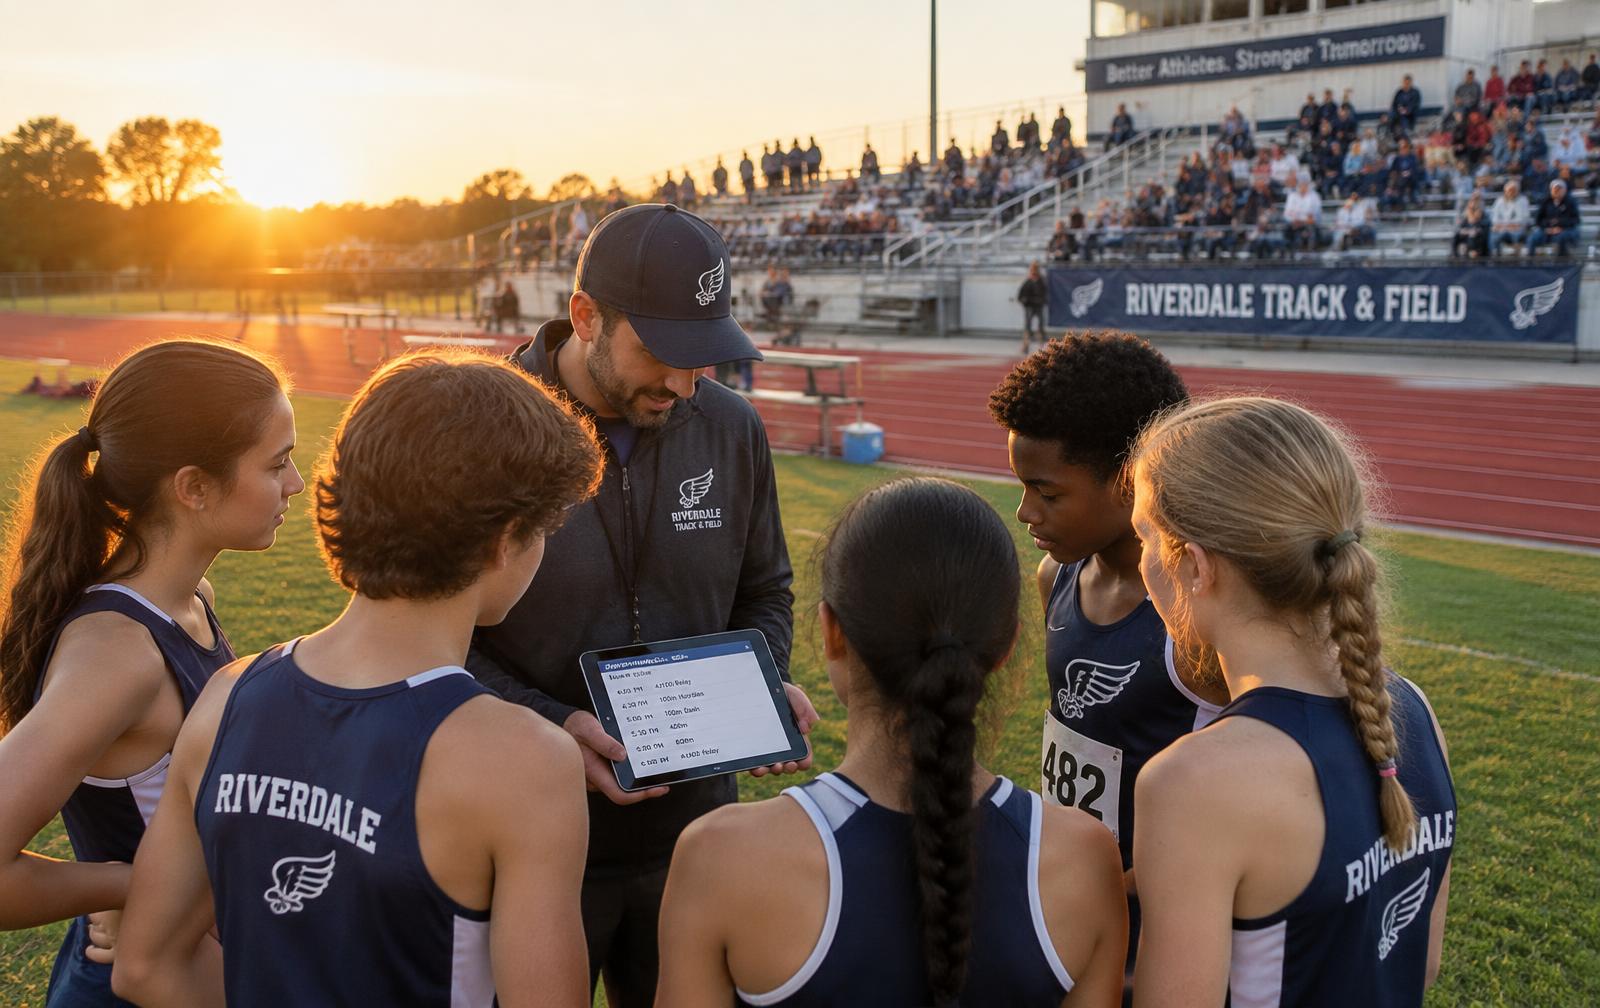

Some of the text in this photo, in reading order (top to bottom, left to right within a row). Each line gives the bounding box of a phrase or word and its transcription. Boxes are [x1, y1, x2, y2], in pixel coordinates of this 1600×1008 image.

[1106, 62, 1154, 84] Better
[1235, 46, 1313, 71] Stronger
[1125, 283, 1468, 322] RIVERDALE TRACK & FIELD
[671, 508, 721, 522] RIVERDALE
[1043, 741, 1106, 822] 482
[214, 773, 382, 855] RIVERDALE
